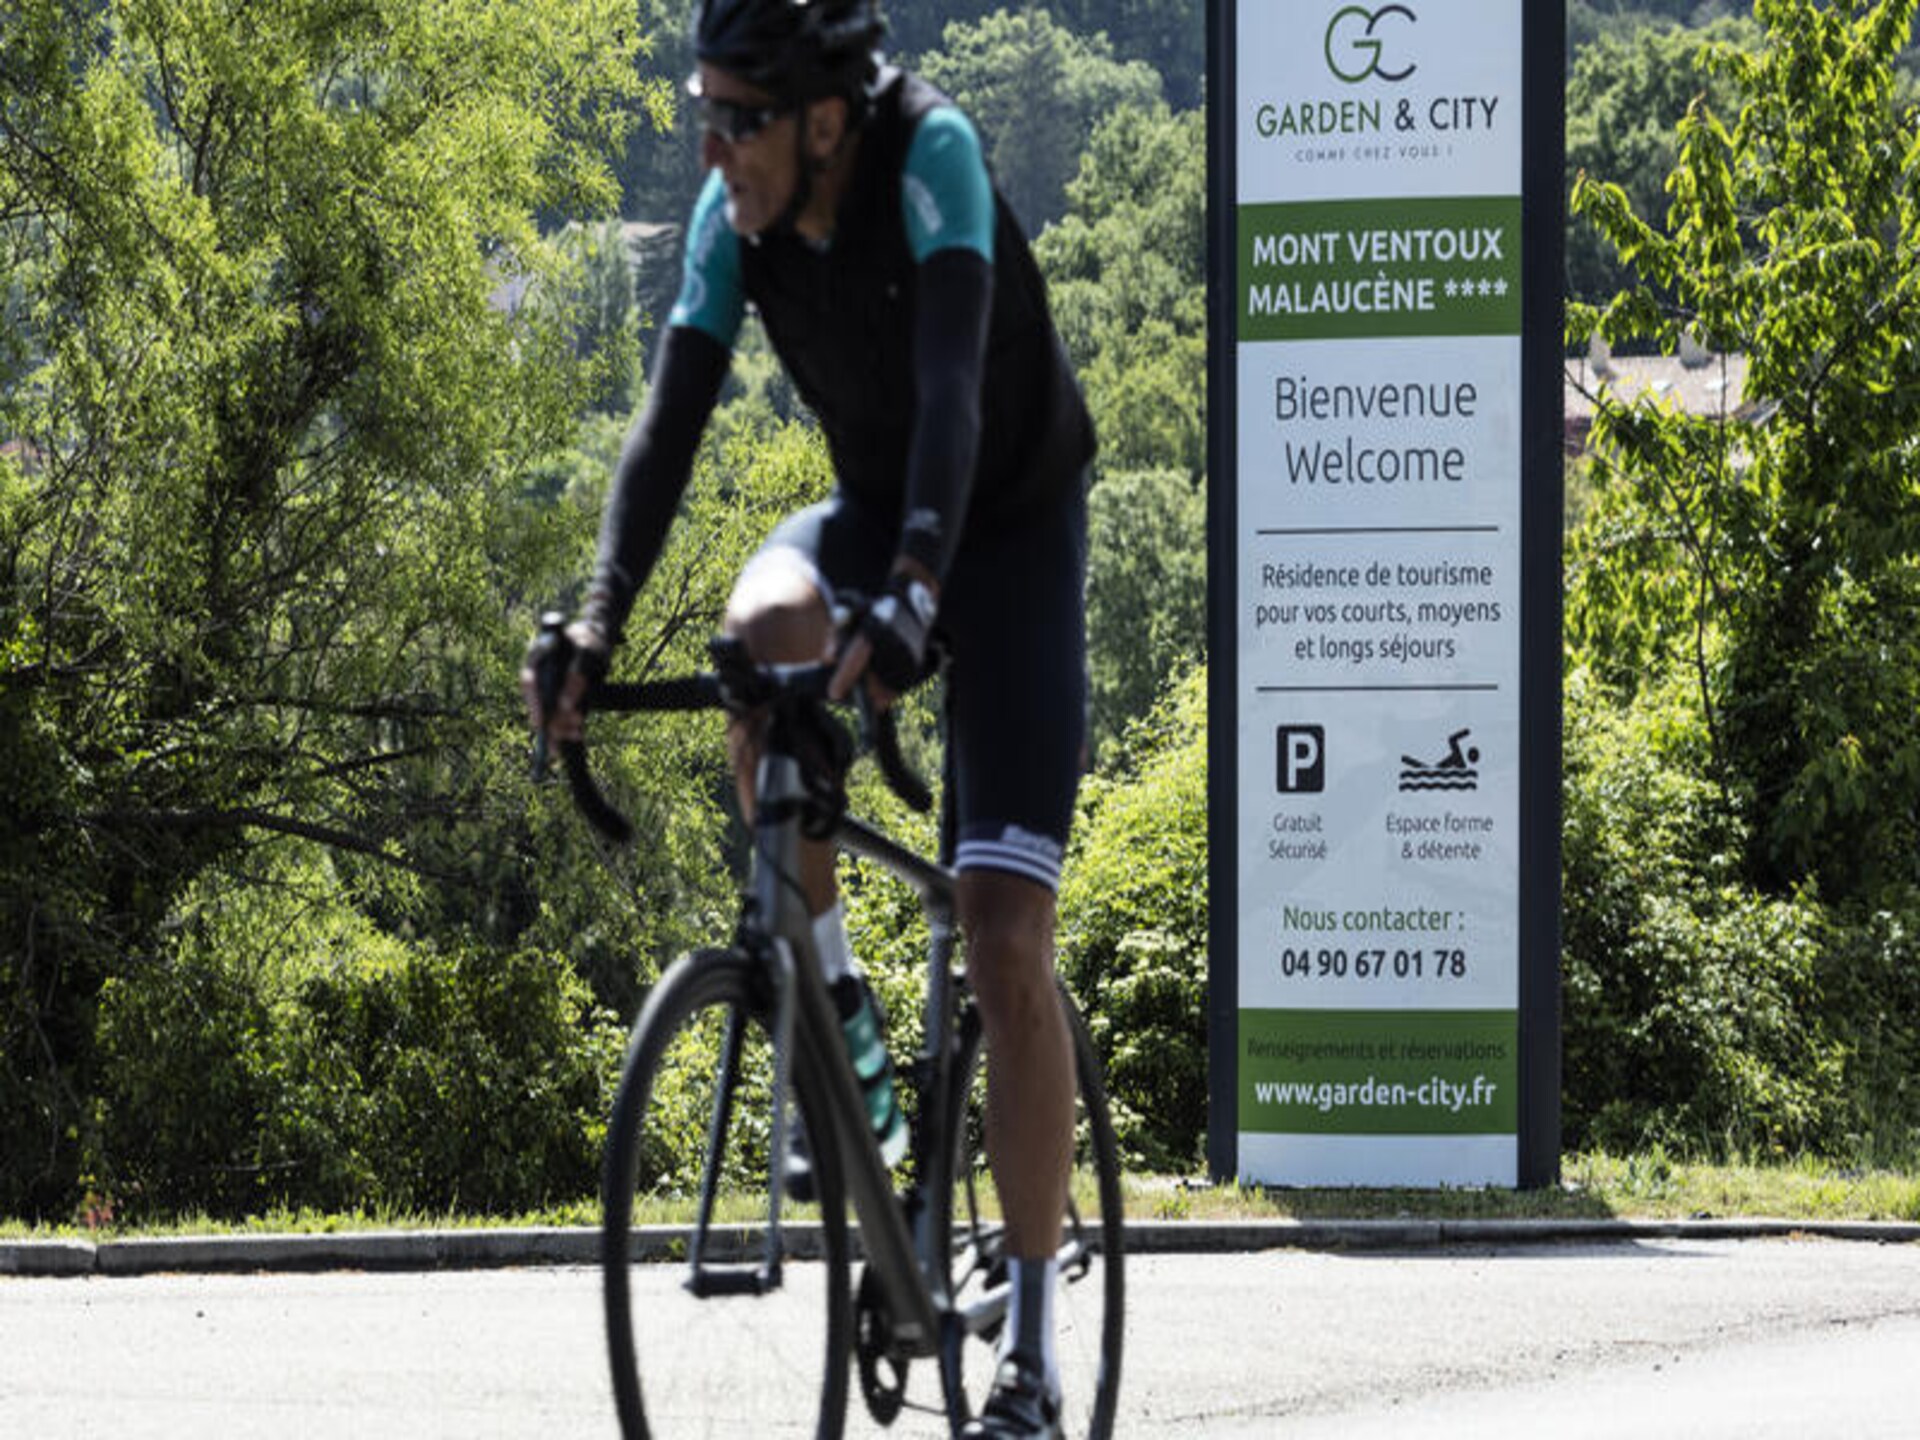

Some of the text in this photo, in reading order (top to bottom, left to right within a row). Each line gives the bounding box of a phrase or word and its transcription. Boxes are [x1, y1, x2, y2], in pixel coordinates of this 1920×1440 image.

[1256, 97, 1498, 137] GARDEN & CITY
[1295, 148, 1345, 162] COMME
[1253, 228, 1504, 266] MONT VENTOUX
[1248, 270, 1435, 315] MALAUCÈNE
[1275, 376, 1477, 420] Bienvenue
[1286, 436, 1464, 484] Welcome
[1262, 561, 1492, 588] Résidence de tourisme
[1256, 601, 1501, 629] pour vos courts, moyens
[1295, 634, 1456, 663] et longs séjours
[1287, 732, 1318, 789] P
[1273, 813, 1323, 832] Gratuit
[1386, 813, 1494, 834] Espace forme
[1268, 839, 1328, 860] Sécurisé
[1401, 840, 1482, 860] & détente
[1283, 907, 1337, 930] Nous
[1342, 907, 1452, 930] contacter
[1282, 949, 1466, 977] 04 90 67 01 78
[1248, 1037, 1506, 1061] Renseignements et réservations
[1255, 1075, 1497, 1111] www.garden-city.fr
